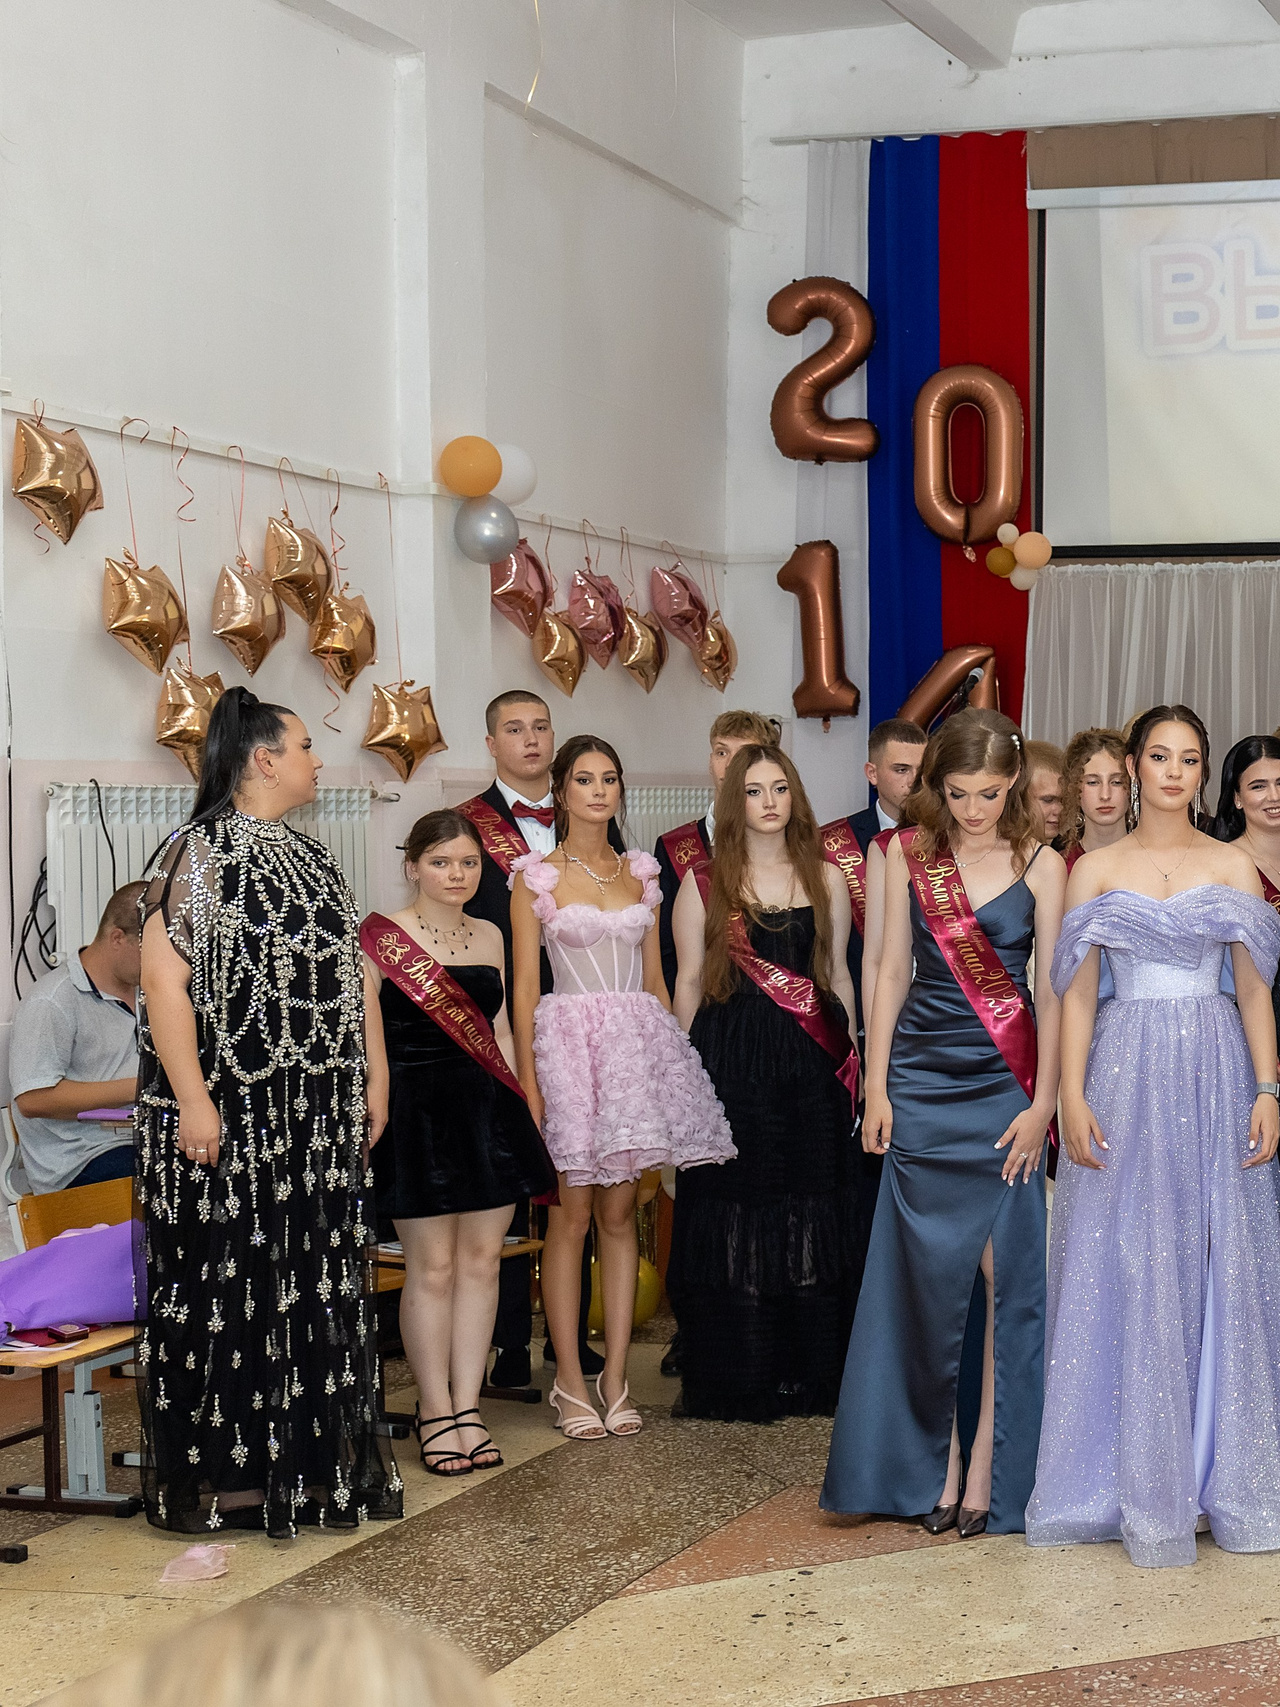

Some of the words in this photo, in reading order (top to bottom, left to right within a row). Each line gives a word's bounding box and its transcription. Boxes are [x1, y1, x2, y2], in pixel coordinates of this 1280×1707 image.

[767, 276, 880, 464] 2
[402, 954, 484, 1053] Выпускница
[925, 859, 986, 977] Выпускница
[975, 968, 1025, 1018] 2025
